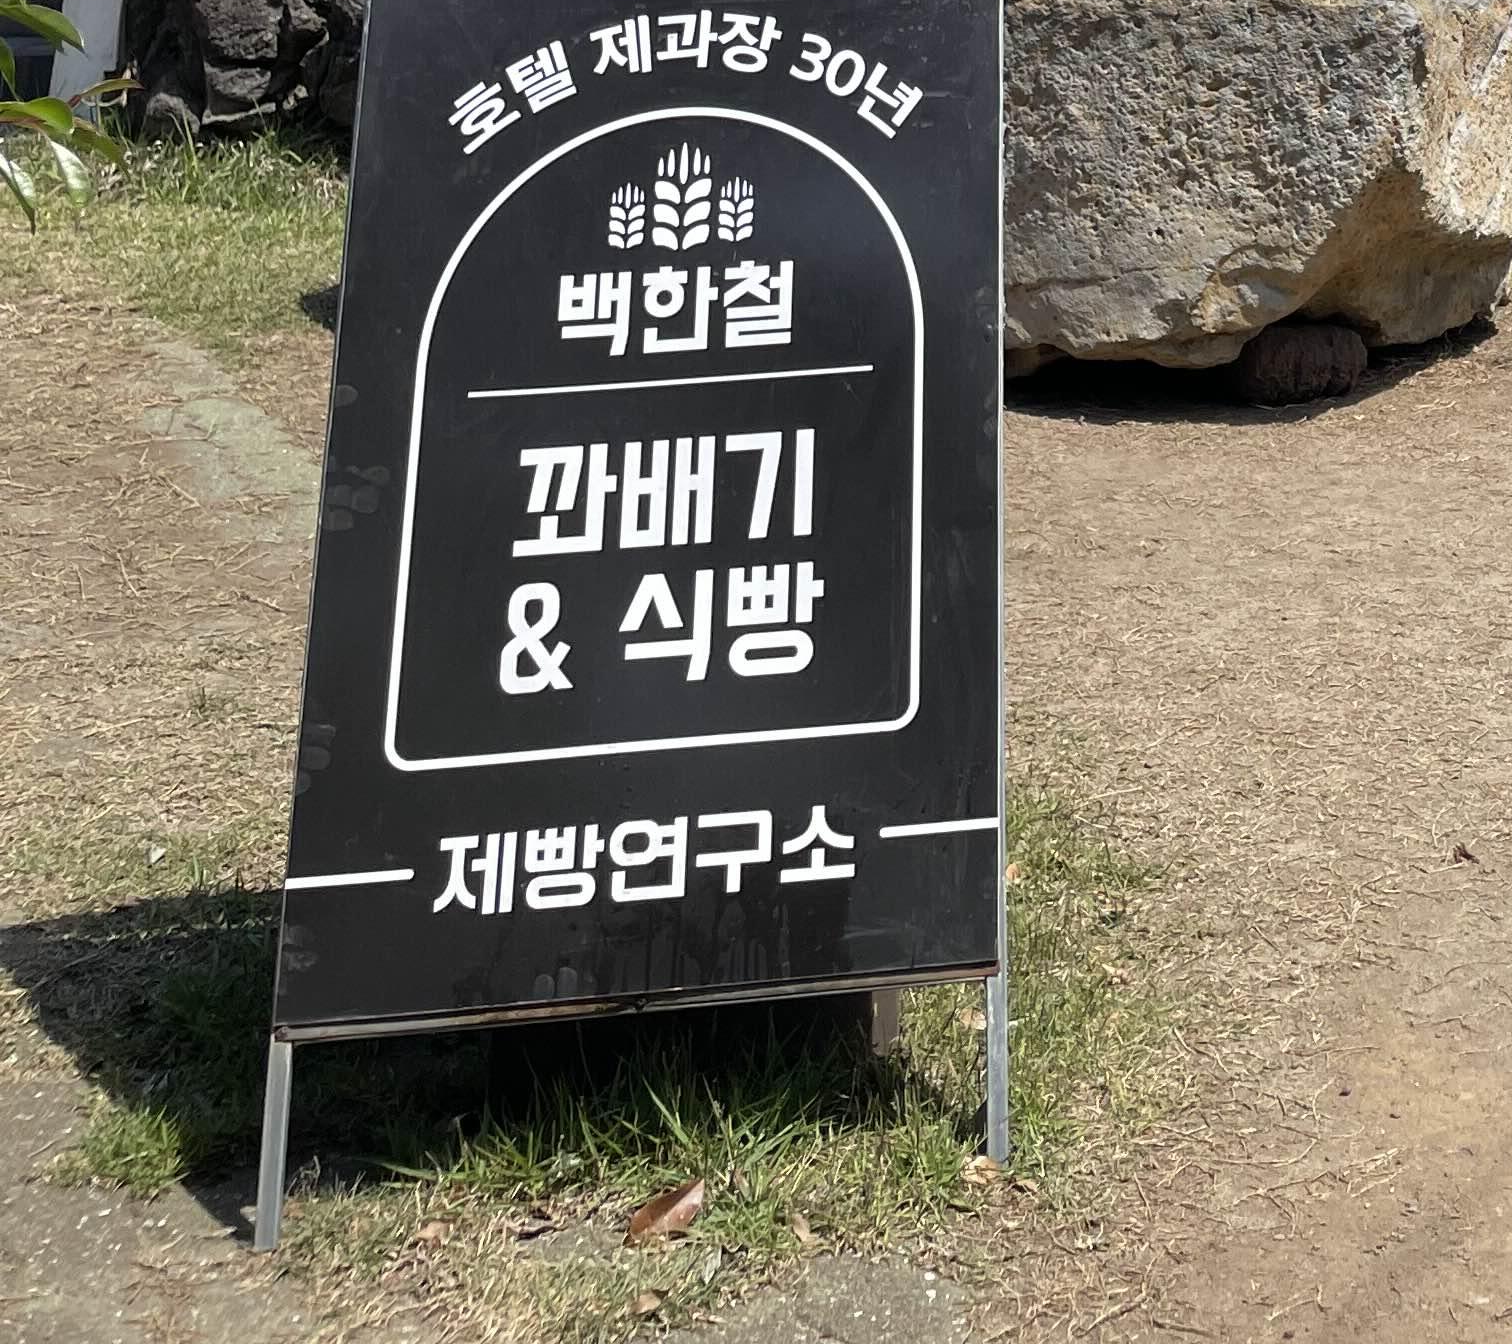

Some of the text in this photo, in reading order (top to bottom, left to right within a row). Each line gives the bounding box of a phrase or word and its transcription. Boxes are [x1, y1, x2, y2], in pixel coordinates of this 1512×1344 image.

[449, 9, 924, 156] 호텔 제과장 30년
[557, 259, 795, 357] 백한철
[512, 427, 816, 558] 꽈배기
[499, 561, 826, 696] & 식빵
[432, 804, 857, 915] 제빵연구소
